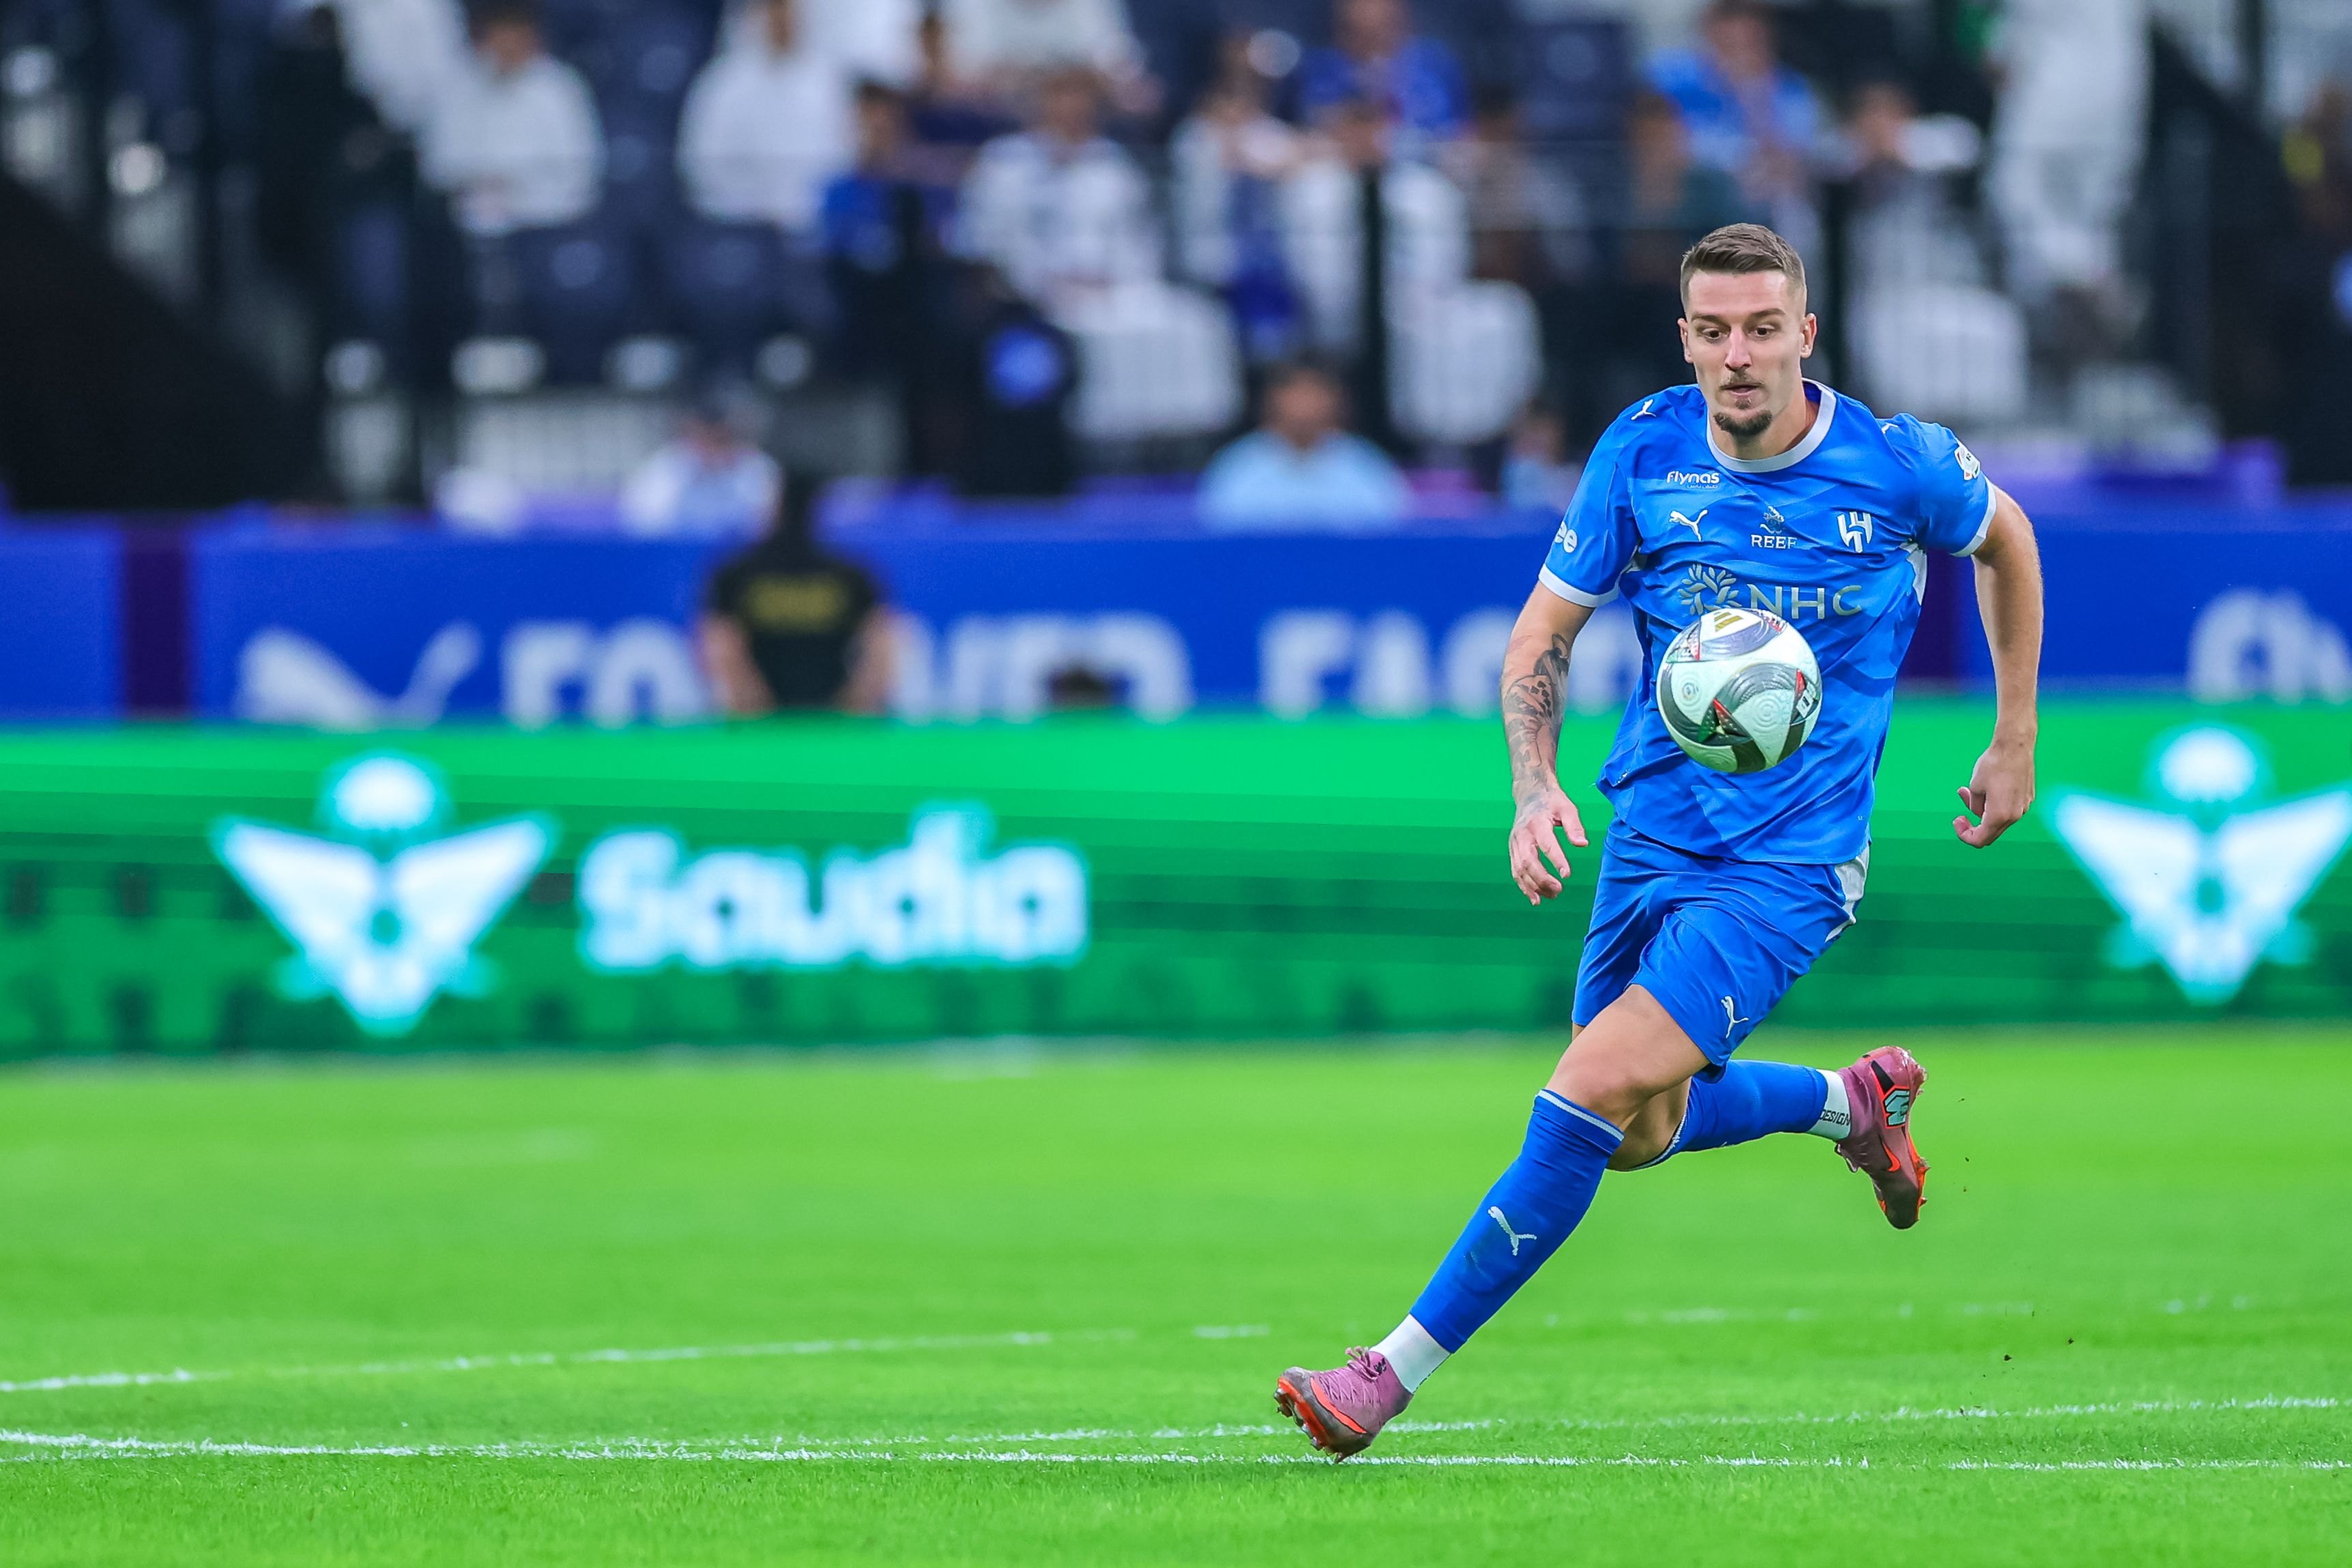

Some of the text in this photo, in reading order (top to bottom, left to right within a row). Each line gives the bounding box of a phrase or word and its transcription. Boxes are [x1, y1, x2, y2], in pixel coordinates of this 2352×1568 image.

[1667, 471, 1719, 484] flynas
[1751, 534, 1797, 549] REEF
[1747, 584, 1863, 619] NHC
[579, 797, 1092, 972] Saudia
[1819, 1109, 1850, 1126] DESIGN
